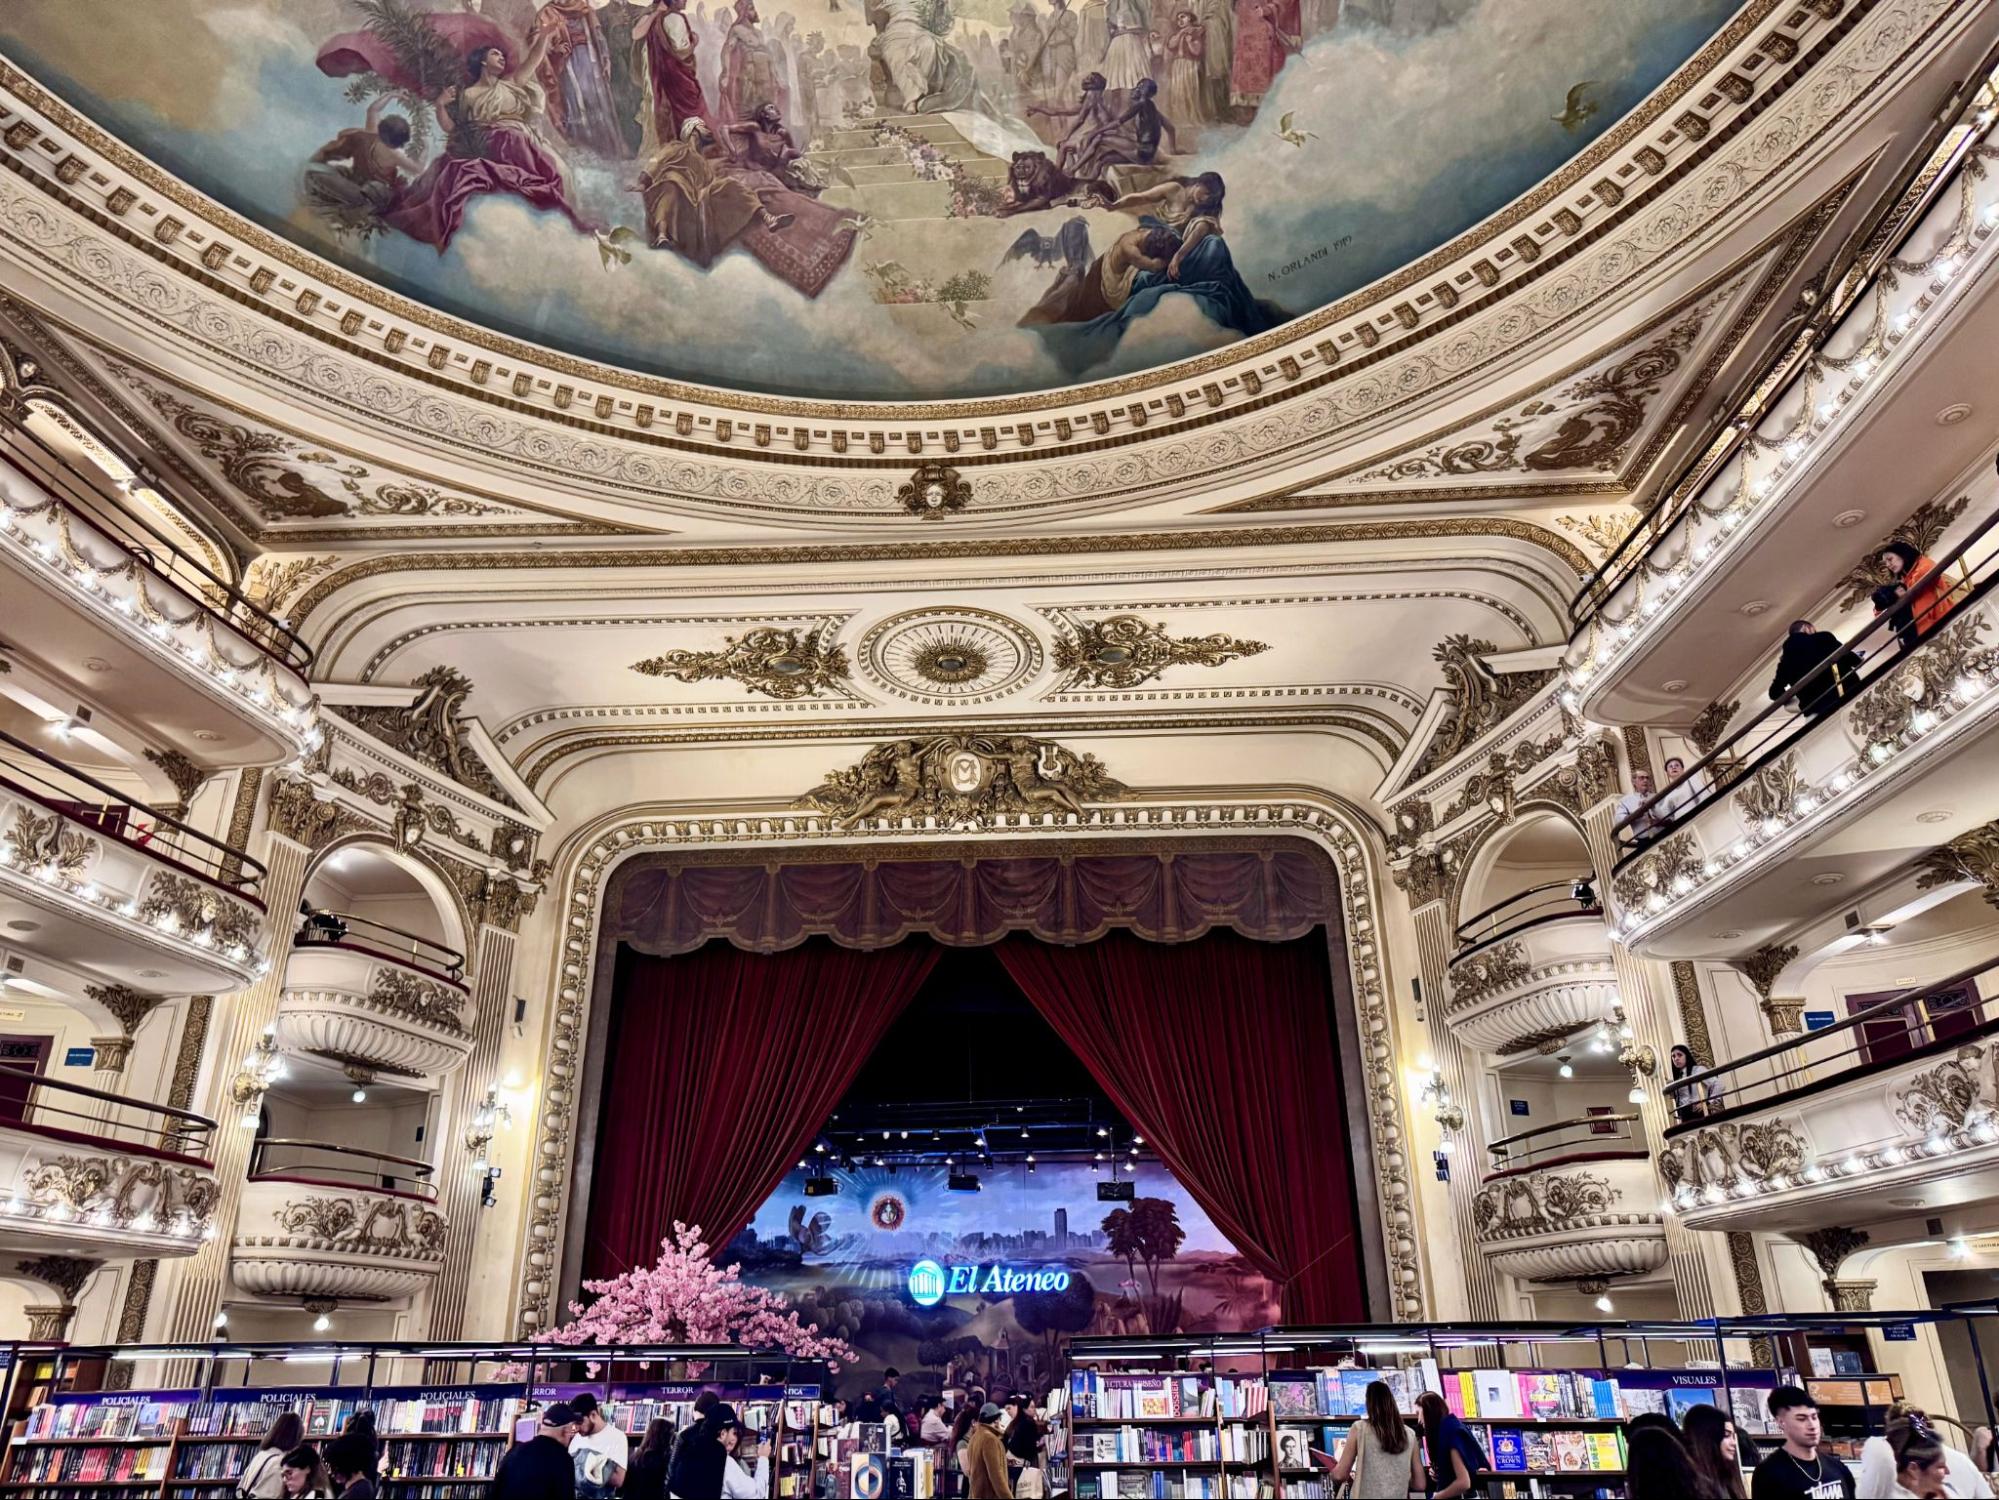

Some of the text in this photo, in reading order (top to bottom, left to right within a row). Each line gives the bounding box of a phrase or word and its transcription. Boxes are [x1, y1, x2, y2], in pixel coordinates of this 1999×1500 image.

[1281, 247, 1328, 275] ORLANDI
[946, 1264, 1069, 1293] El Ateneo
[1672, 1375, 1717, 1385] VISUALES
[661, 1386, 694, 1394] TERROR
[101, 1395, 151, 1406] POLICIALES
[260, 1393, 316, 1403] POLICIALES
[420, 1391, 476, 1401] POLICIALES
[1171, 1380, 1181, 1417] DOSSIER
